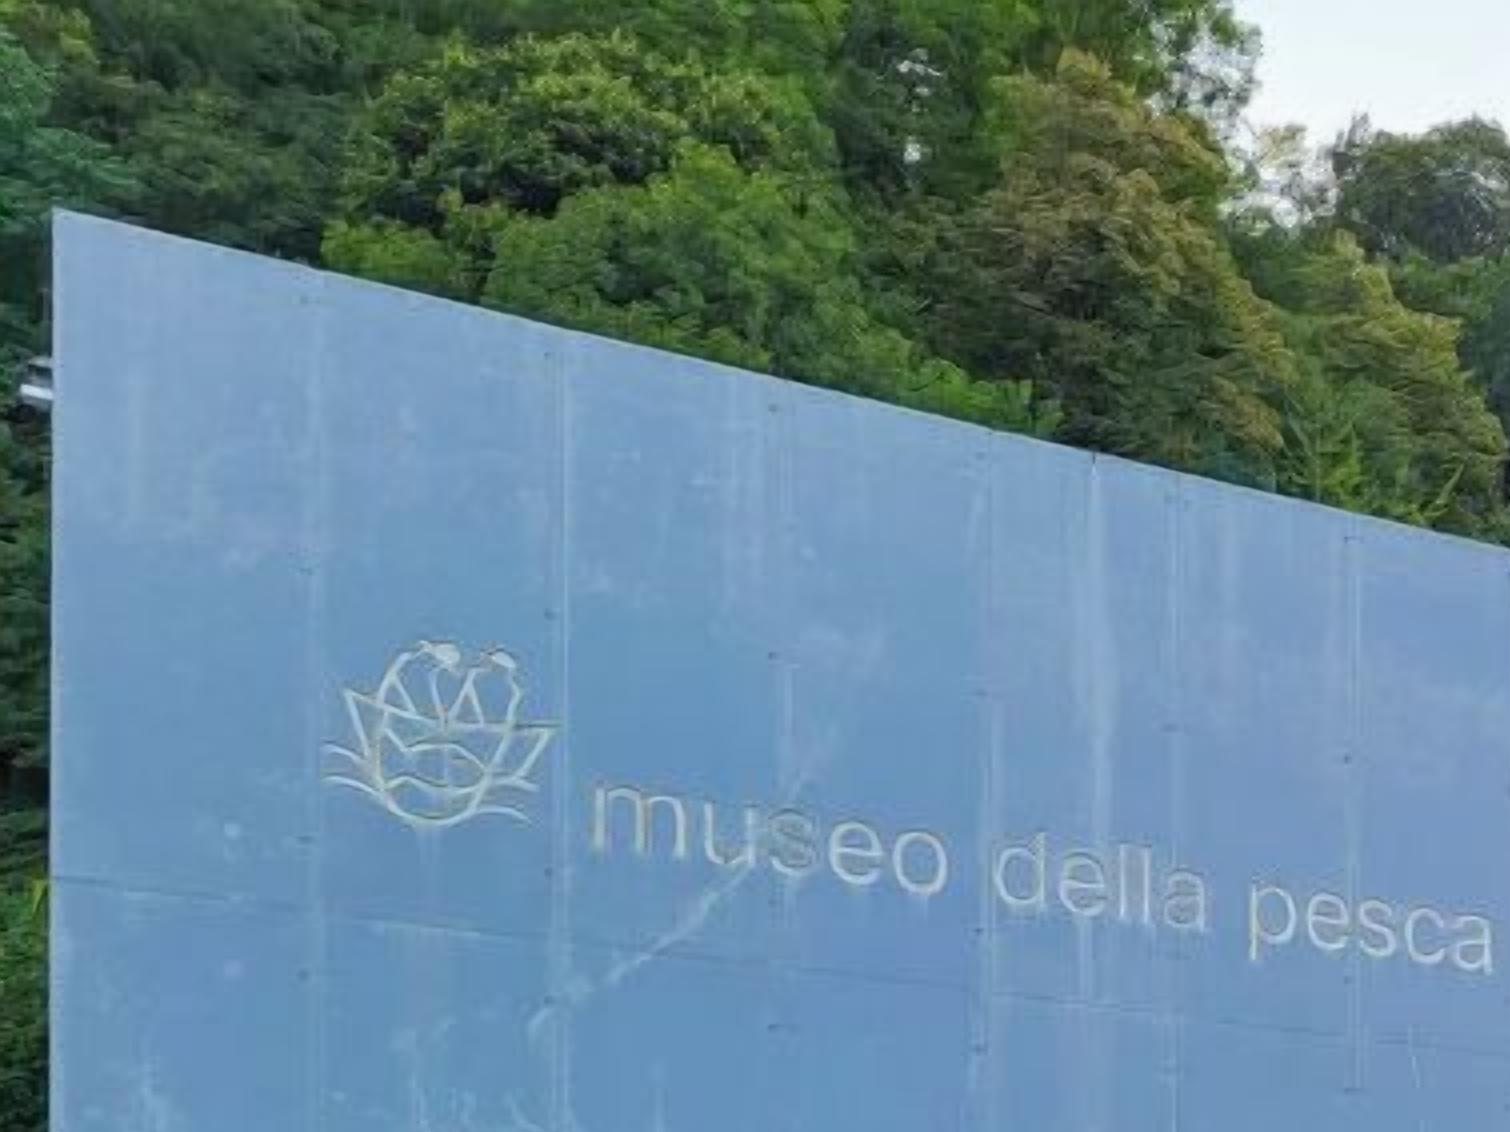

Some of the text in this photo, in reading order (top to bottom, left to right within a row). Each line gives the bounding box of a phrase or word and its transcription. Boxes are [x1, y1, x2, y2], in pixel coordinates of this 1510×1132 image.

[591, 780, 1494, 975] museo della pesca
